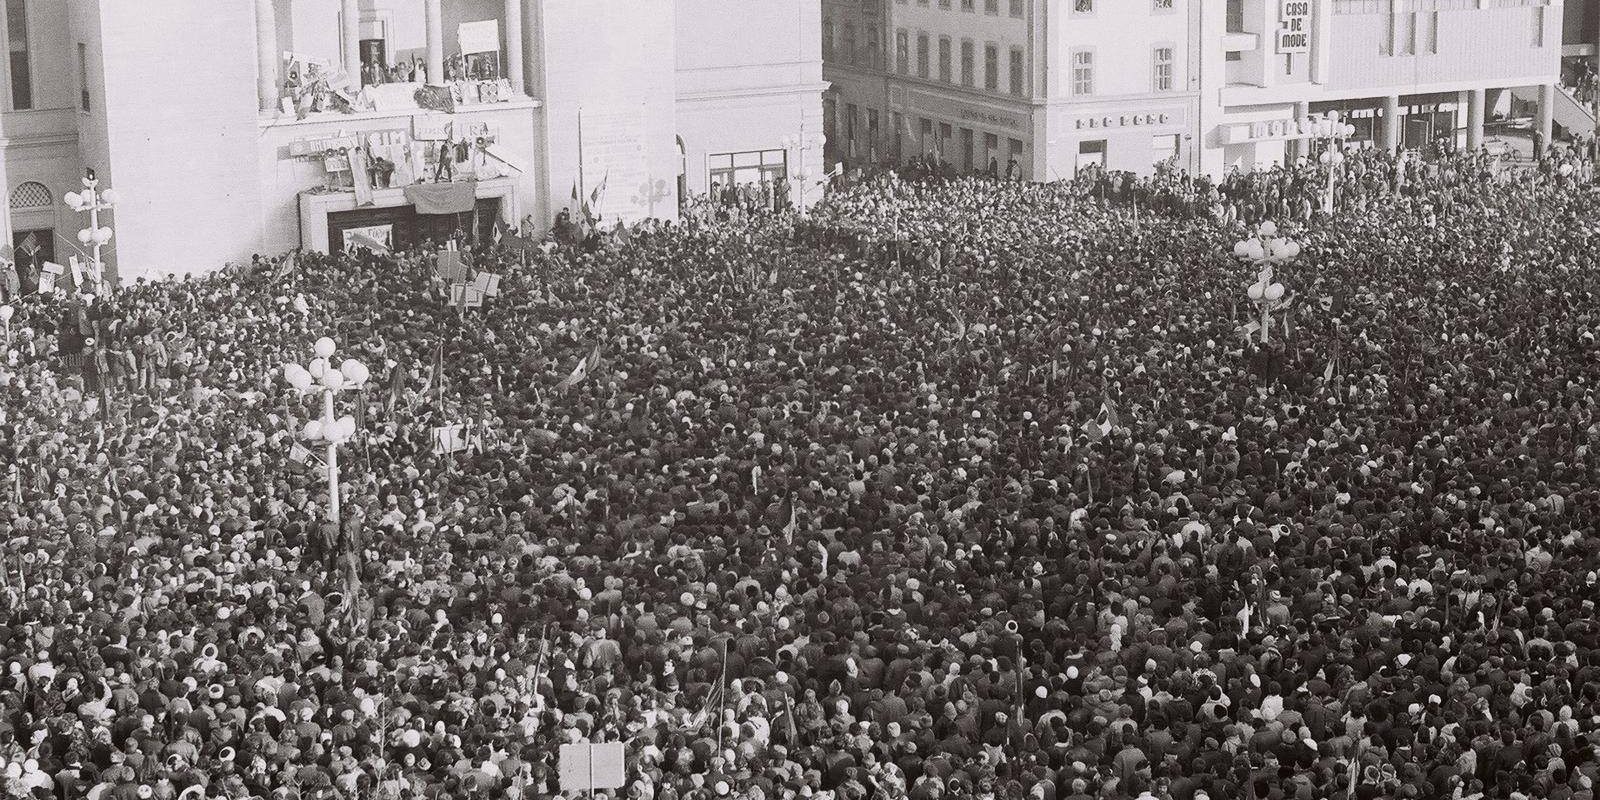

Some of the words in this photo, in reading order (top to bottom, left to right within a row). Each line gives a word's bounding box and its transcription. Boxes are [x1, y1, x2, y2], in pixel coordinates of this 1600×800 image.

[1286, 2, 1308, 16] CASA
[1291, 18, 1302, 31] DE
[1282, 34, 1307, 48] MODE
